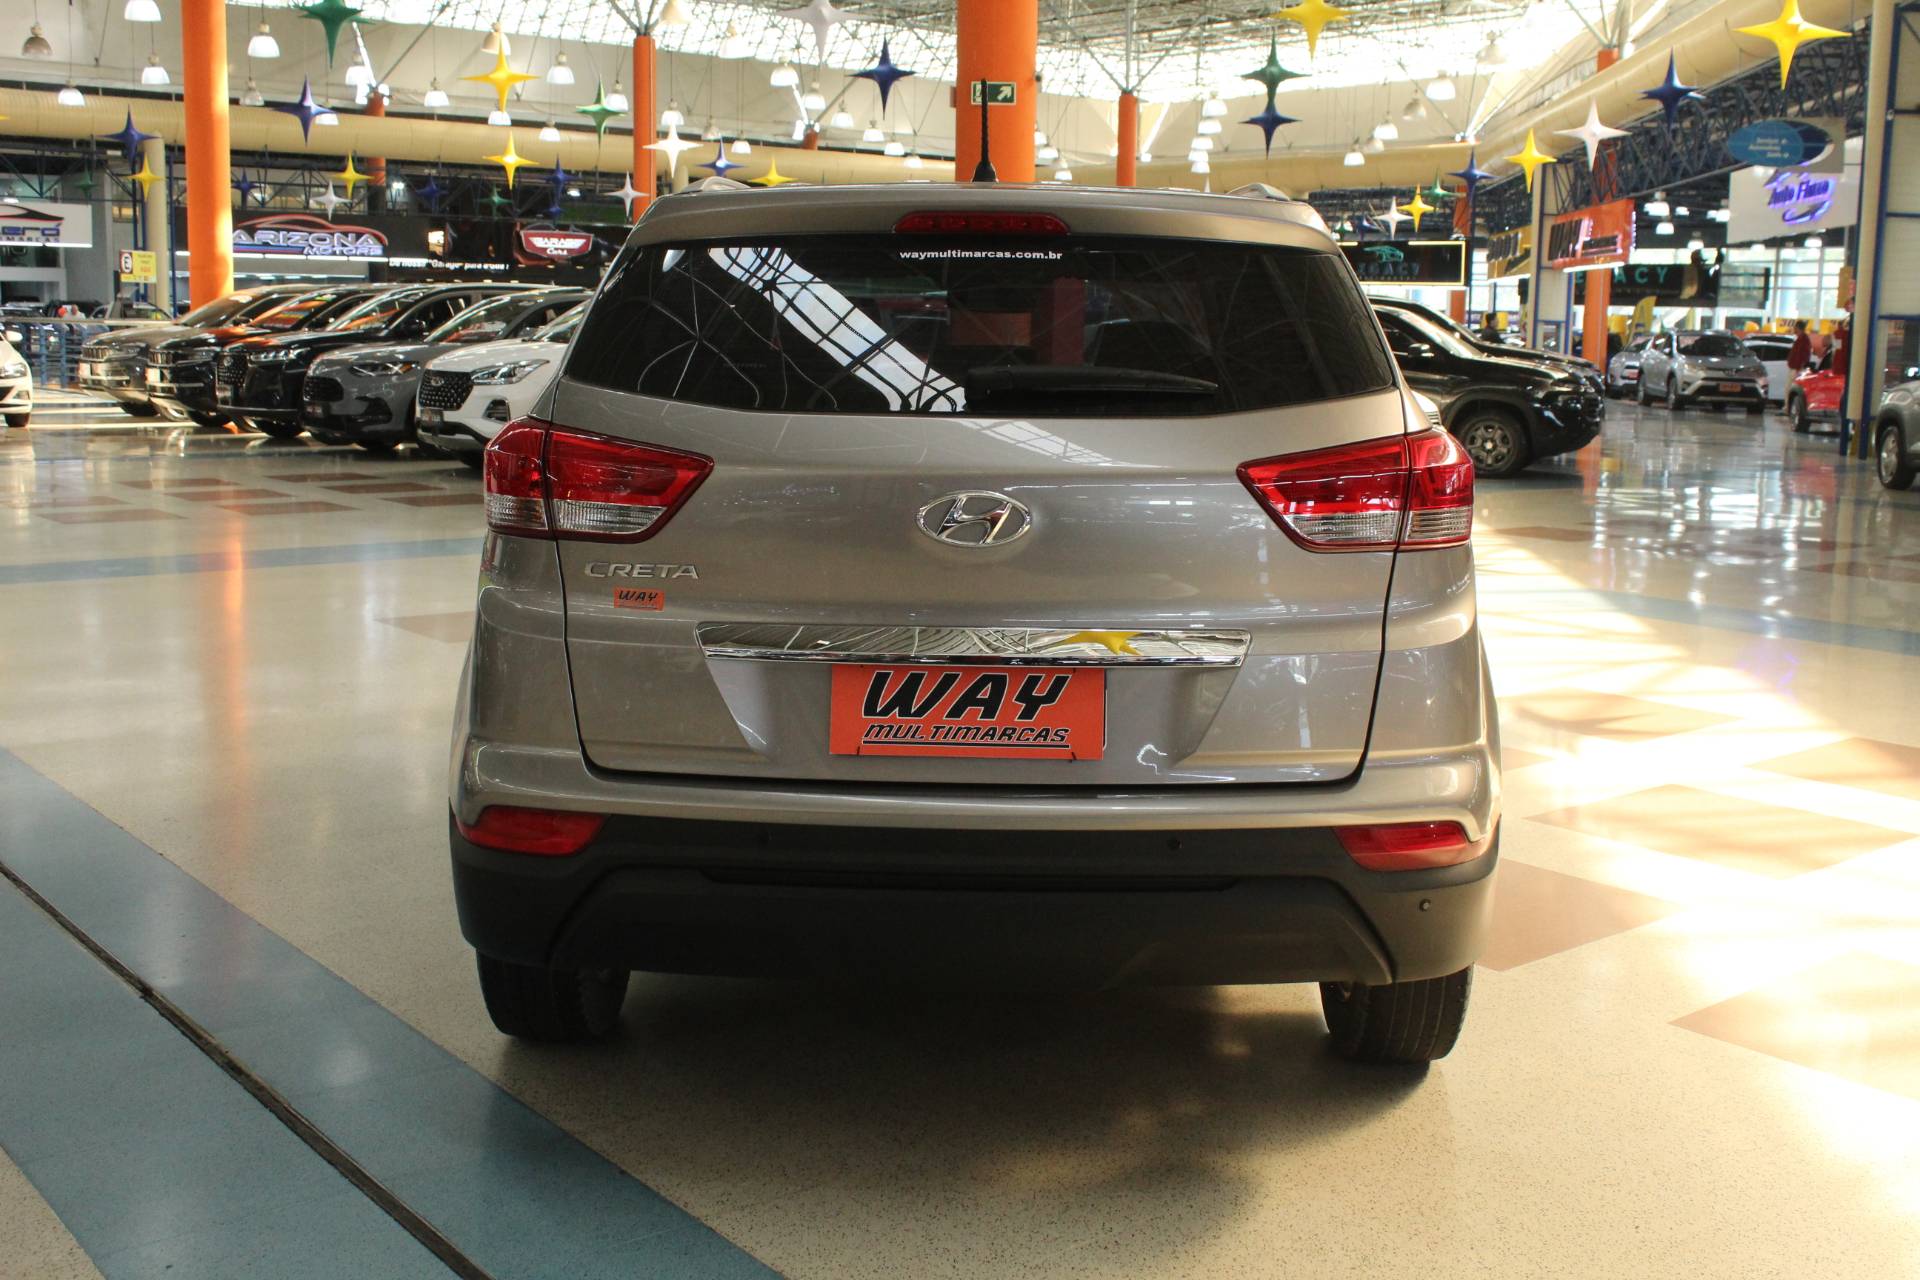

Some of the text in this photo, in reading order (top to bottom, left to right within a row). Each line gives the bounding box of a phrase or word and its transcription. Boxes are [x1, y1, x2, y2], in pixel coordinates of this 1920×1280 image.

[233, 228, 383, 248] ARIZONA
[528, 237, 587, 249] GARAGE
[303, 245, 383, 256] MOTORS
[900, 249, 1063, 260] waymultimarcas.com.br
[583, 561, 700, 580] CRETA
[618, 590, 659, 602] WAY
[862, 670, 1073, 722] WAY
[863, 723, 1070, 743] MULTIMARCAS
